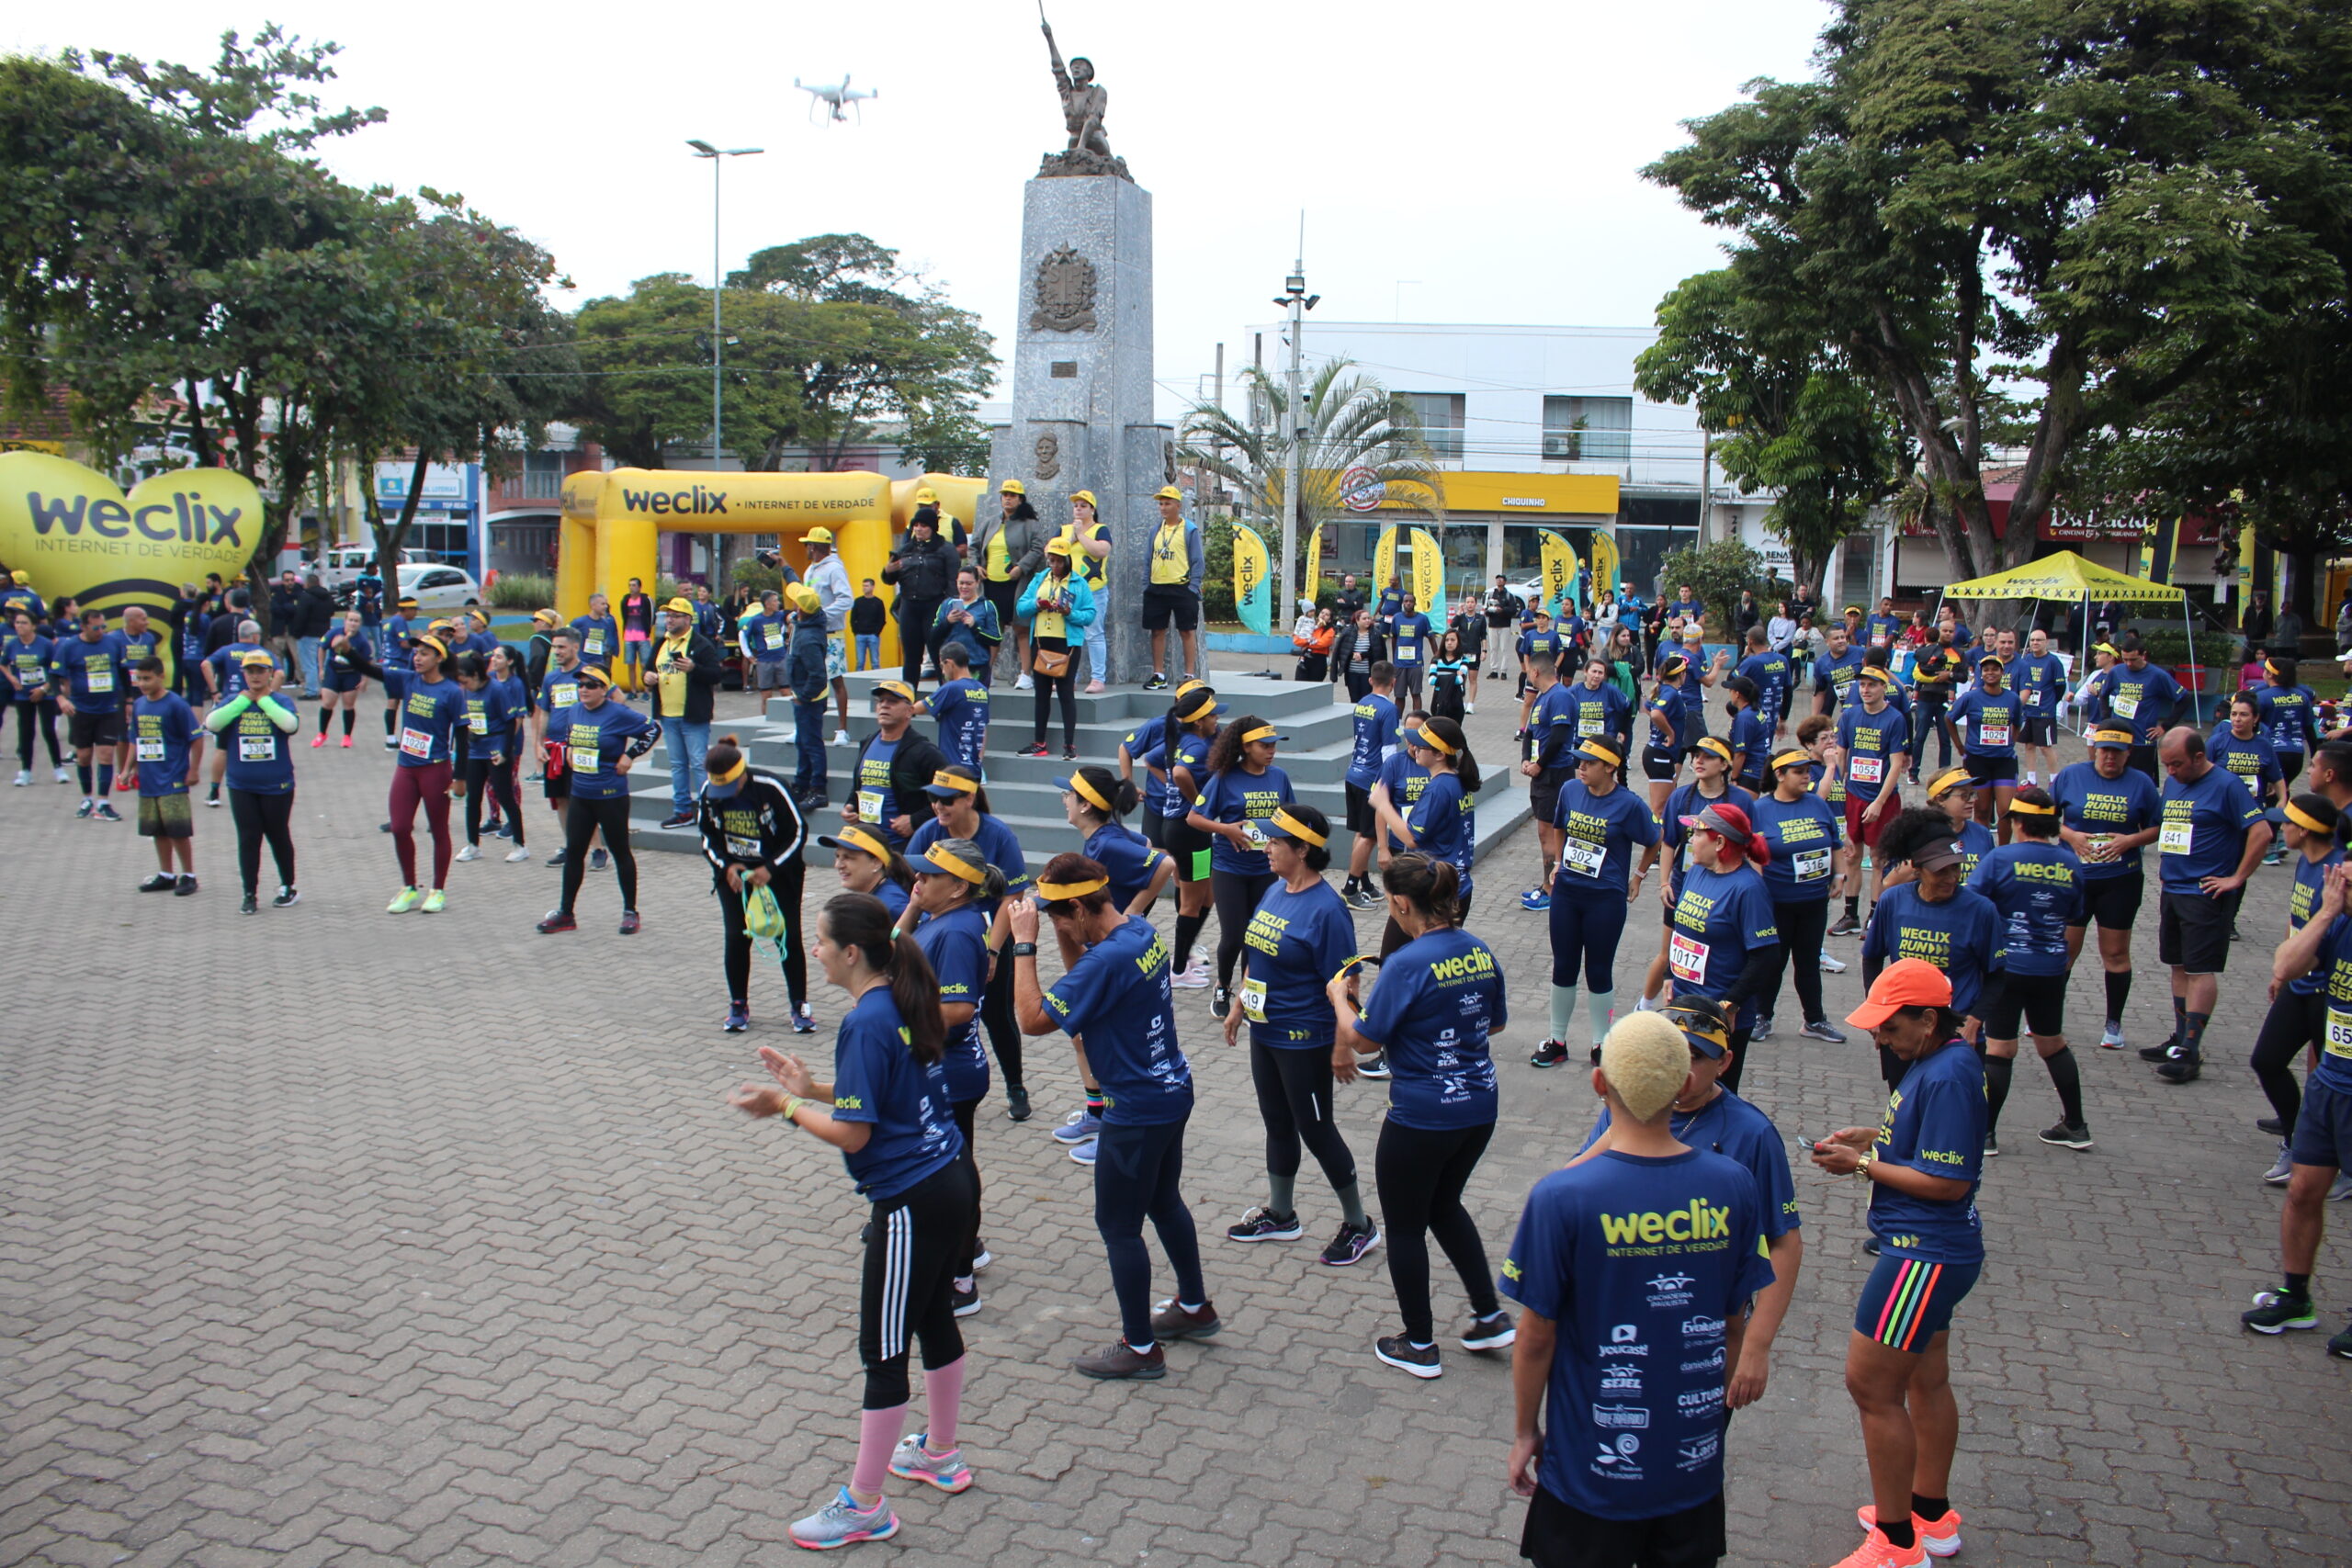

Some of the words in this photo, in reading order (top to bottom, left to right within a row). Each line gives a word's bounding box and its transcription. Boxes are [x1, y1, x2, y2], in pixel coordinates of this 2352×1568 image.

[623, 485, 728, 514] weclix
[744, 500, 800, 509] INTERNET
[805, 501, 819, 509] DE
[822, 498, 875, 509] VERDADE
[1502, 497, 1545, 507] CHIQUINHO
[27, 491, 243, 548] weclix
[35, 538, 130, 556] INTERNET
[138, 543, 163, 558] DE
[169, 545, 242, 564] VERDADE
[1240, 556, 1253, 606] weclix
[1551, 558, 1563, 604] weclix
[1596, 557, 1604, 597] weclix
[560, 691, 574, 701] 532
[2272, 694, 2303, 705] weclix
[2117, 703, 2130, 712] 540
[1583, 724, 1598, 733] 663
[247, 745, 266, 754] 330
[404, 737, 425, 750] 1020
[576, 755, 593, 765] 581
[2228, 751, 2259, 761] WECLIX
[1854, 764, 1876, 775] 1052
[1243, 791, 1280, 800] WECLIX
[2086, 793, 2128, 804] WECLIX
[1245, 800, 1267, 808] RUN
[2084, 802, 2112, 810] RUN
[2165, 800, 2195, 808] WECLIX
[1245, 808, 1275, 818] SERIE
[1570, 809, 1609, 828] WECLIX
[2083, 809, 2128, 823] SERIES
[2163, 808, 2180, 818] RUN
[1566, 819, 1590, 832] RUN
[1566, 829, 1605, 844] SERIES
[1782, 829, 1825, 844] SERIES
[2164, 832, 2181, 843] 641
[1570, 849, 1592, 864] 302
[1804, 859, 1824, 873] 316
[2014, 861, 2074, 882] weclix
[1683, 890, 1715, 909] WECLIX
[1674, 910, 1706, 933] SERIES
[1900, 927, 1951, 943] WECLIX
[1244, 931, 1279, 957] SERIES
[1899, 940, 1929, 954] RUN
[1430, 947, 1495, 981] weclix
[1672, 947, 1700, 969] 1017
[1438, 977, 1465, 988] INTERNET
[2332, 1025, 2352, 1043] 65
[2335, 1045, 2352, 1055] wec
[835, 1095, 862, 1110] eclix
[1922, 1148, 1964, 1166] weclix
[1600, 1198, 1730, 1245] weclix
[1606, 1247, 1663, 1258] INTERNET
[1667, 1245, 1681, 1255] DE
[1684, 1239, 1729, 1253] VERDADE
